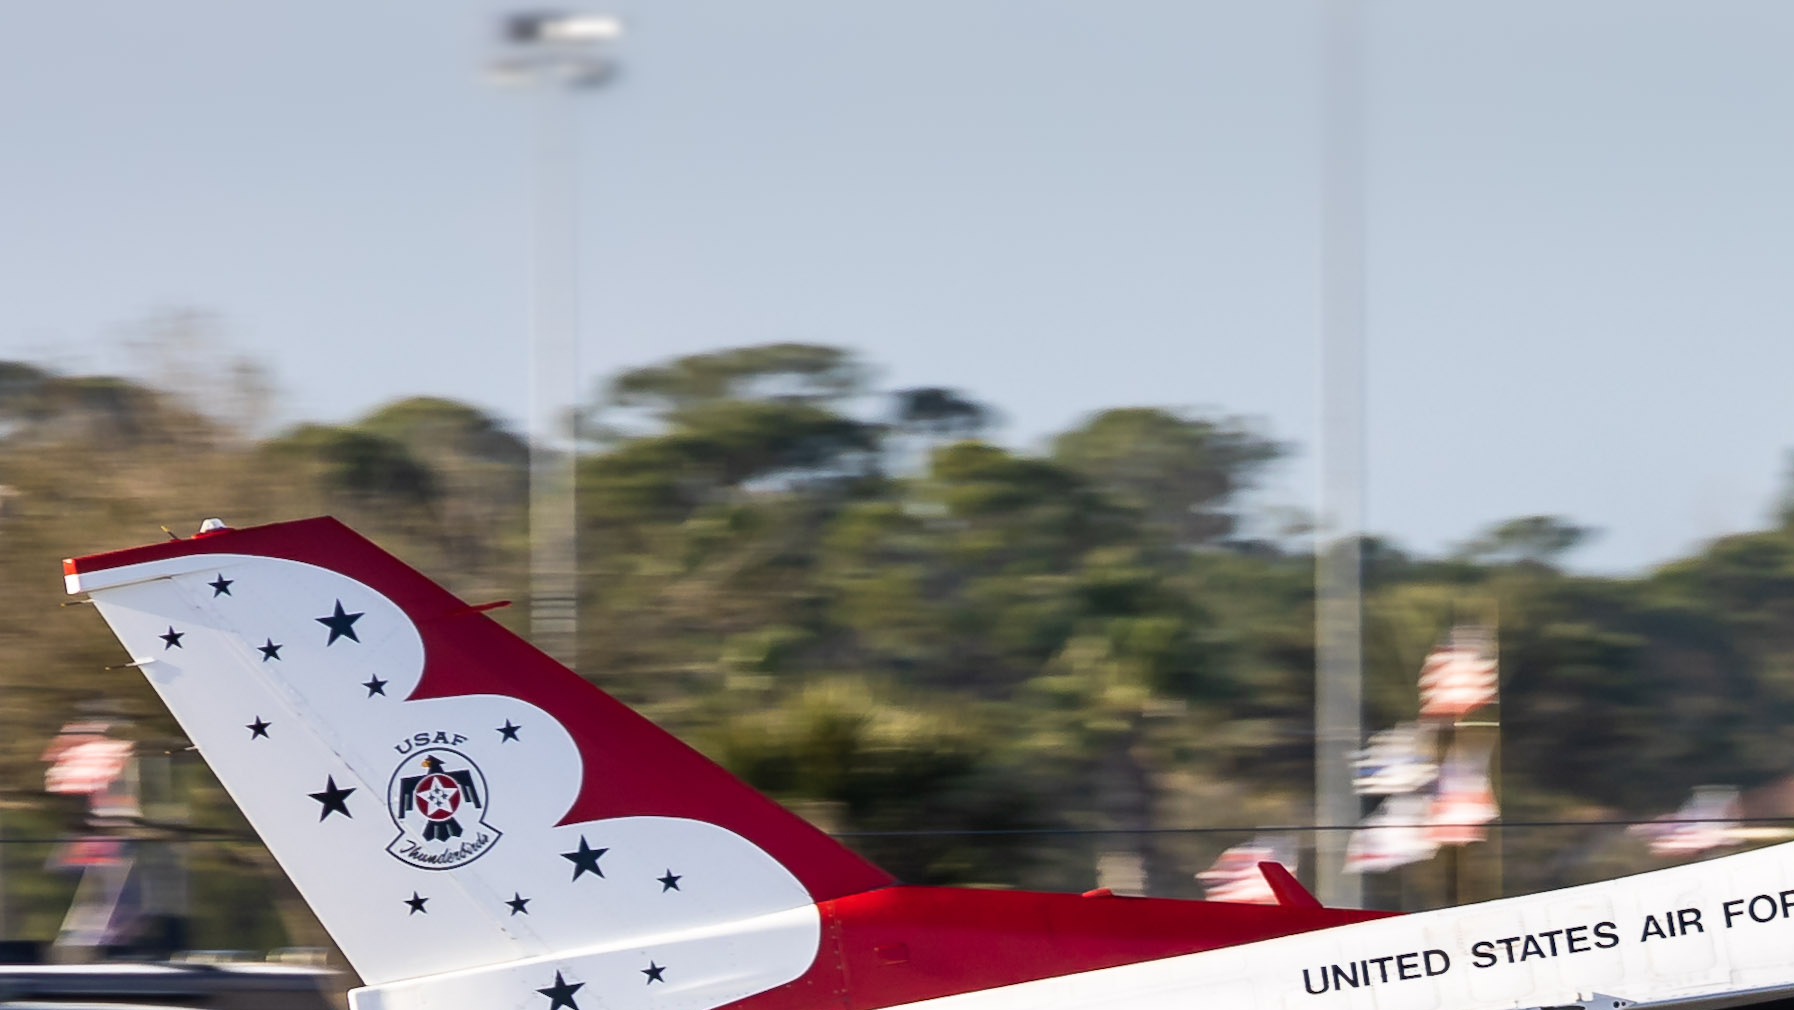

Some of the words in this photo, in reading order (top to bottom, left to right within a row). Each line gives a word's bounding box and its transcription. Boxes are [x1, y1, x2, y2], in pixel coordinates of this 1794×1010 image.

[394, 731, 469, 755] USAF
[399, 832, 490, 864] Thunderbirds
[1302, 949, 1451, 995] UNITED
[1471, 921, 1620, 969] STATES
[1640, 907, 1704, 943] AIR
